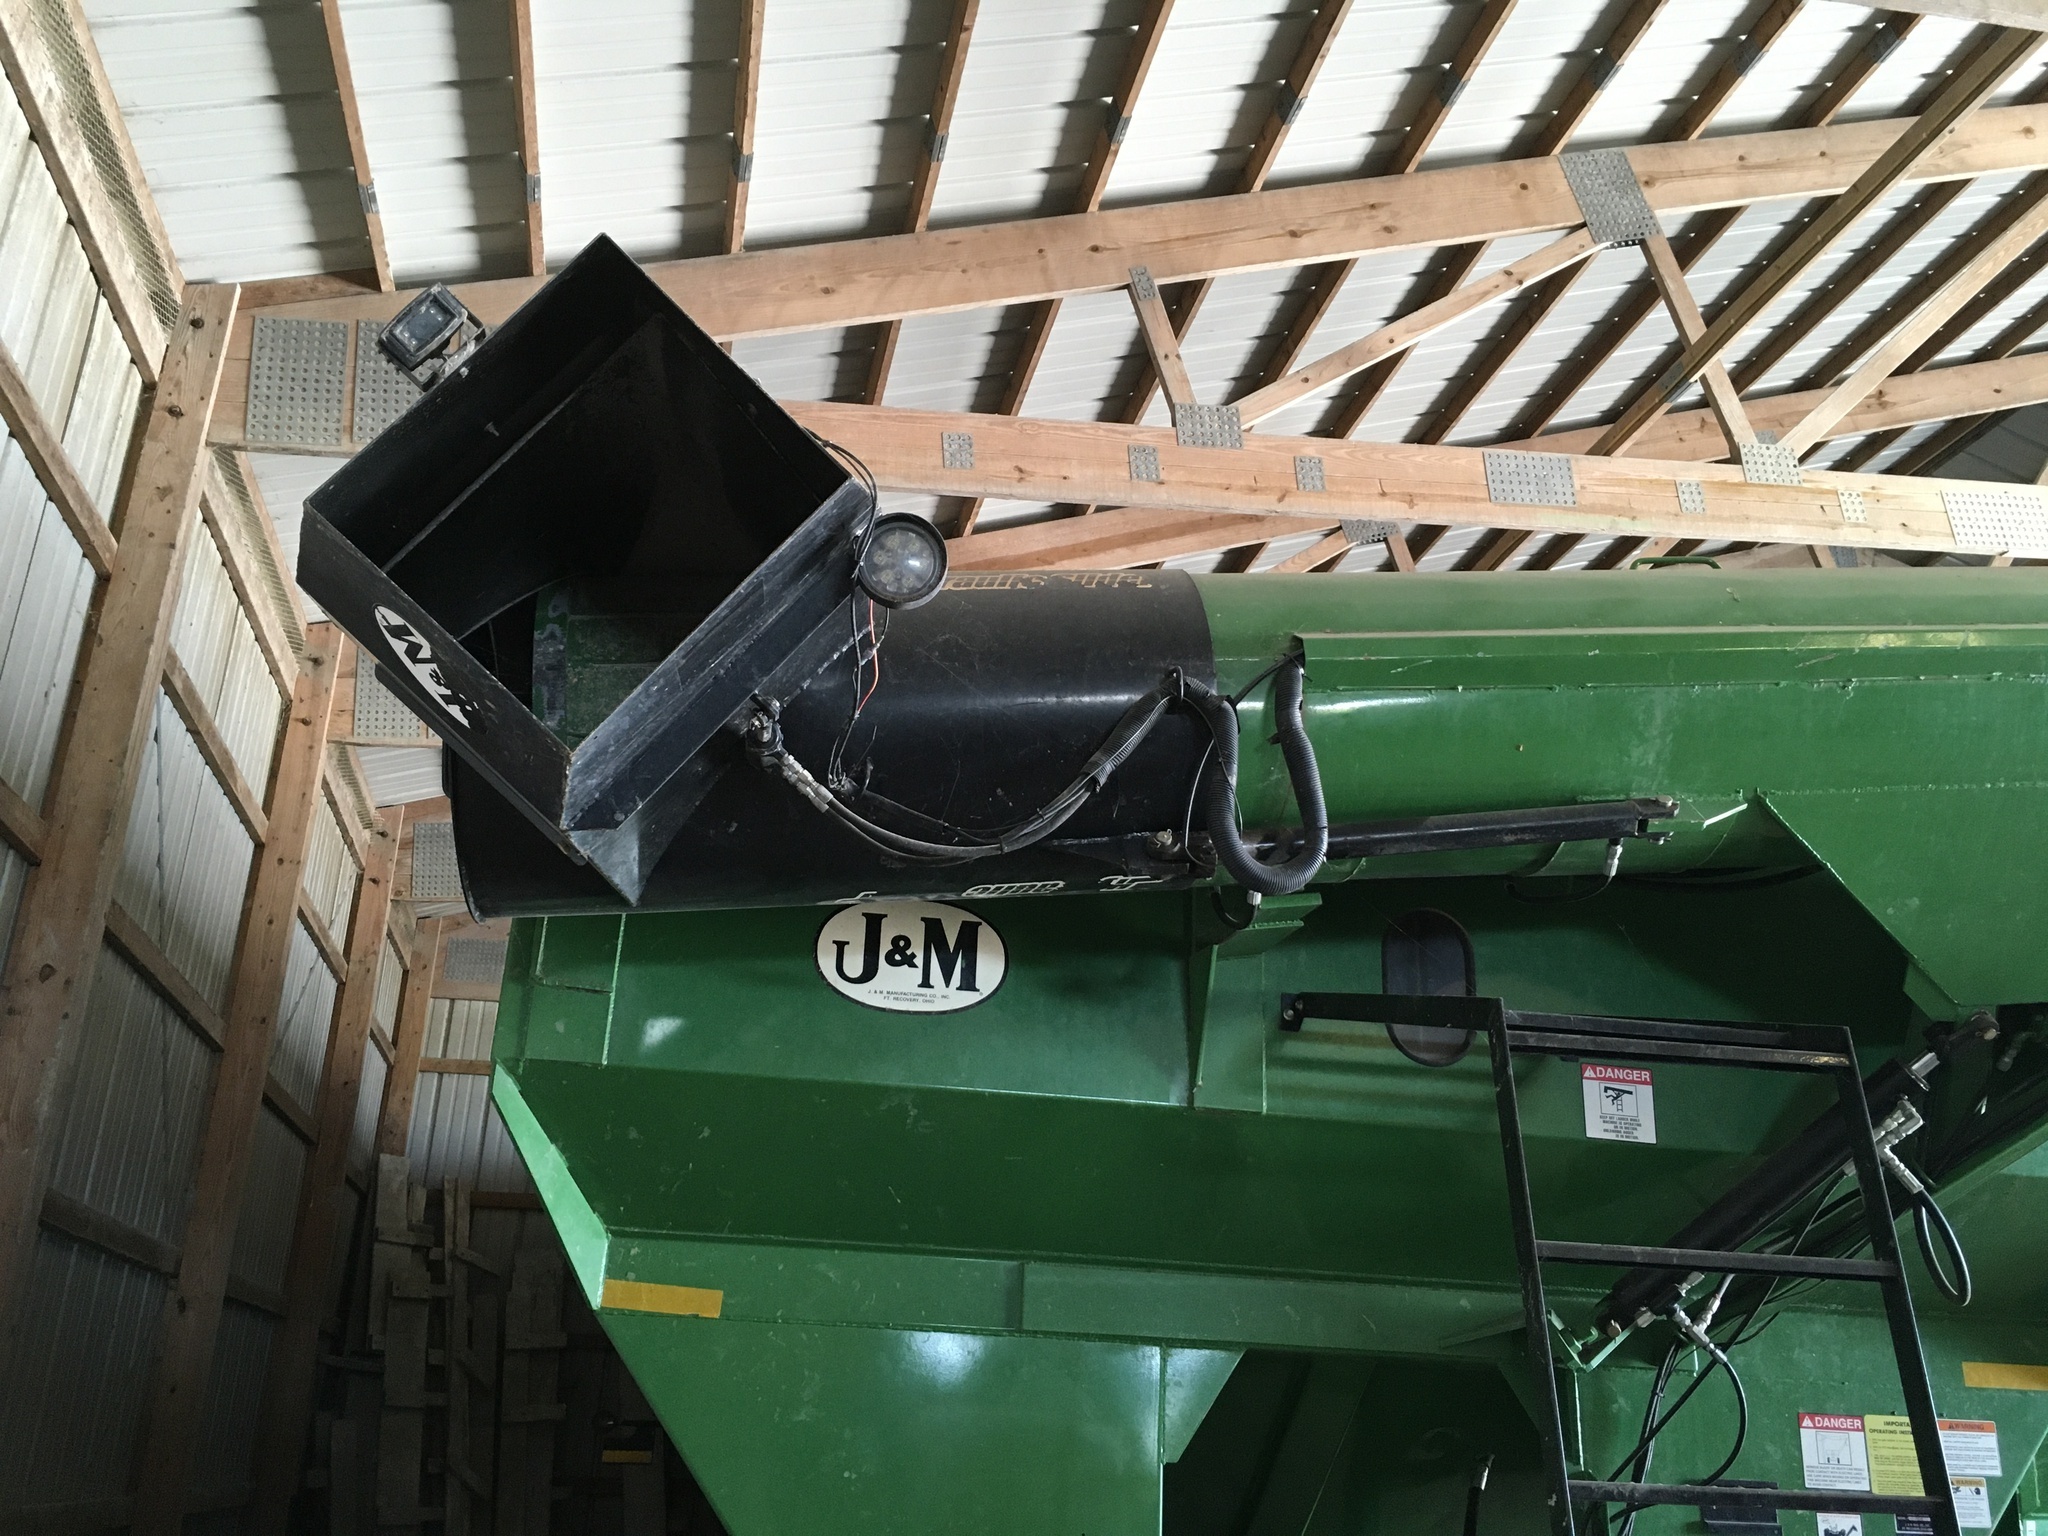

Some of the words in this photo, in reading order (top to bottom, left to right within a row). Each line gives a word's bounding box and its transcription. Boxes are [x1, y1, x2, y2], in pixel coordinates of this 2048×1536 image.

[832, 912, 983, 993] J&M
[886, 990, 928, 998] MANUFACTURING
[1597, 1067, 1650, 1082] DANGER
[1814, 1416, 1862, 1430] DANGER
